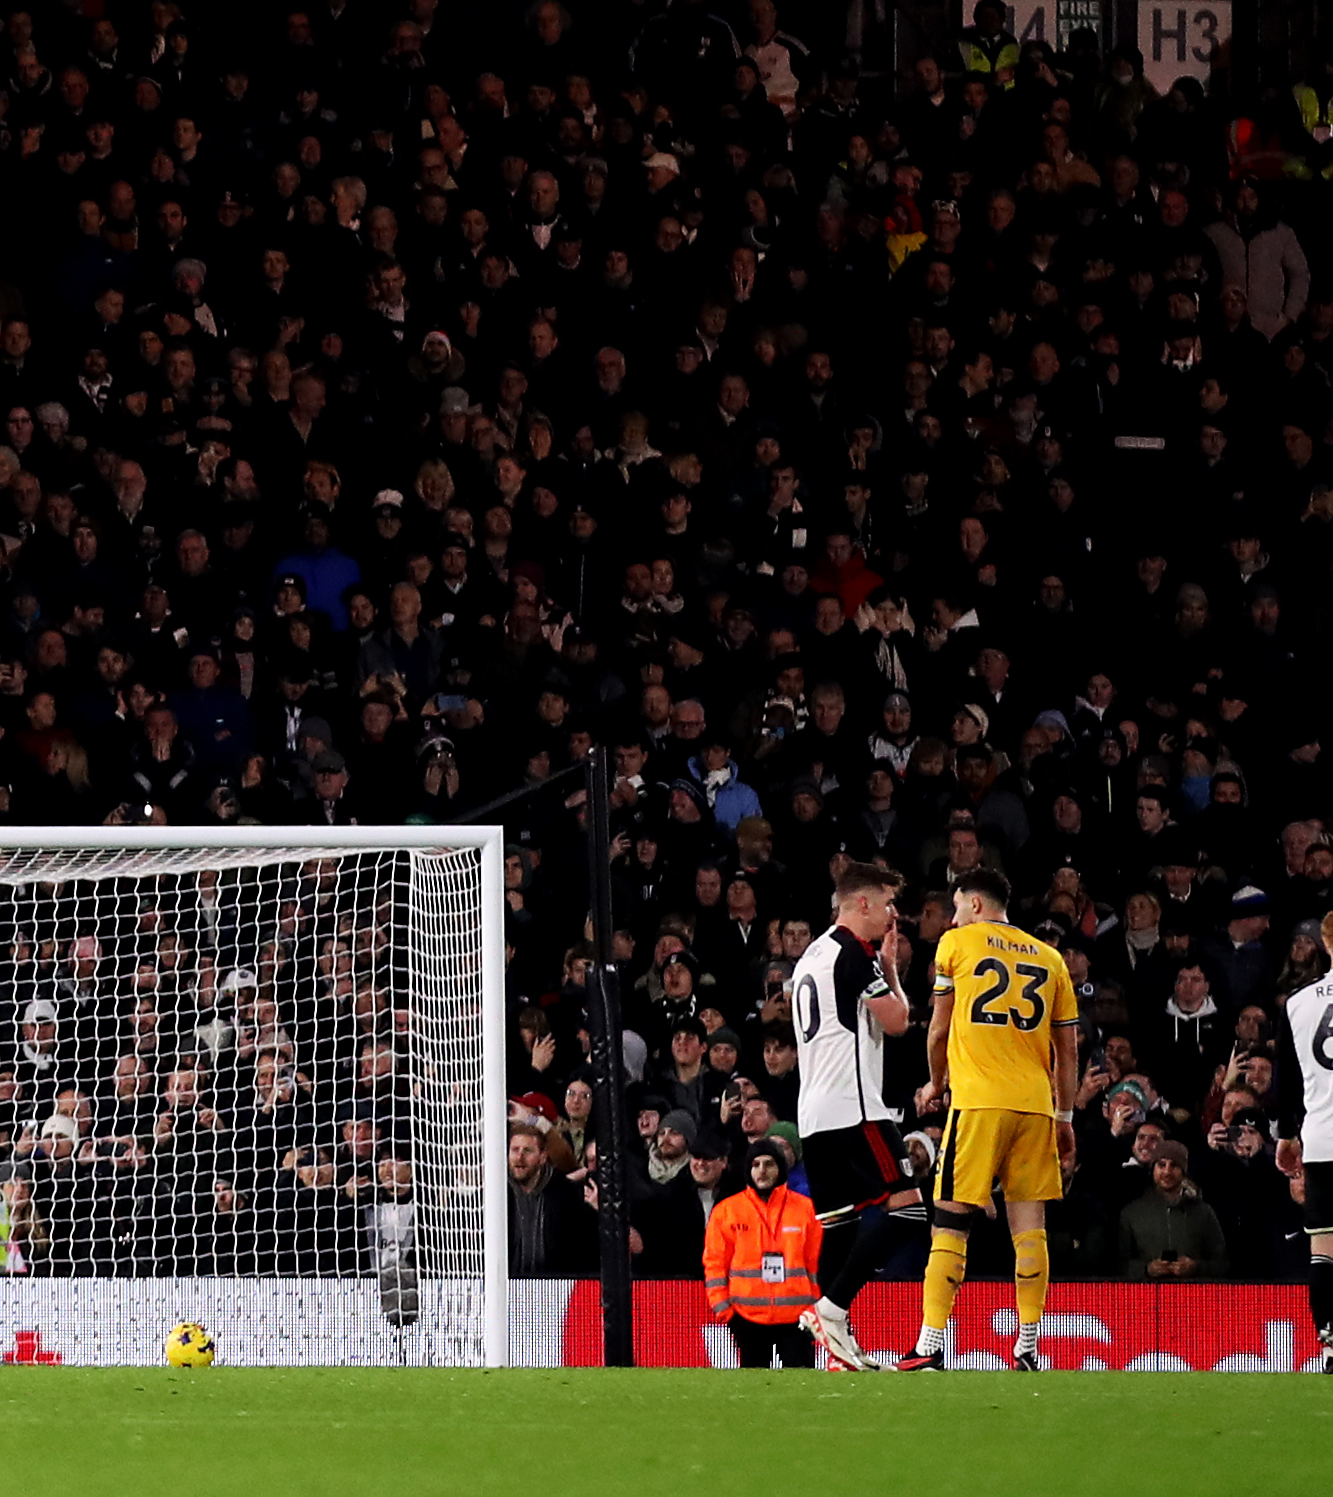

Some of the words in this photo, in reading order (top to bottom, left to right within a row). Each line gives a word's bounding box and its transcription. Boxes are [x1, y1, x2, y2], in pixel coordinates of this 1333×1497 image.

[1058, 0, 1100, 16] FIRE
[1152, 8, 1219, 63] H3
[987, 935, 1039, 955] KILMAN
[970, 956, 1049, 1032] 23
